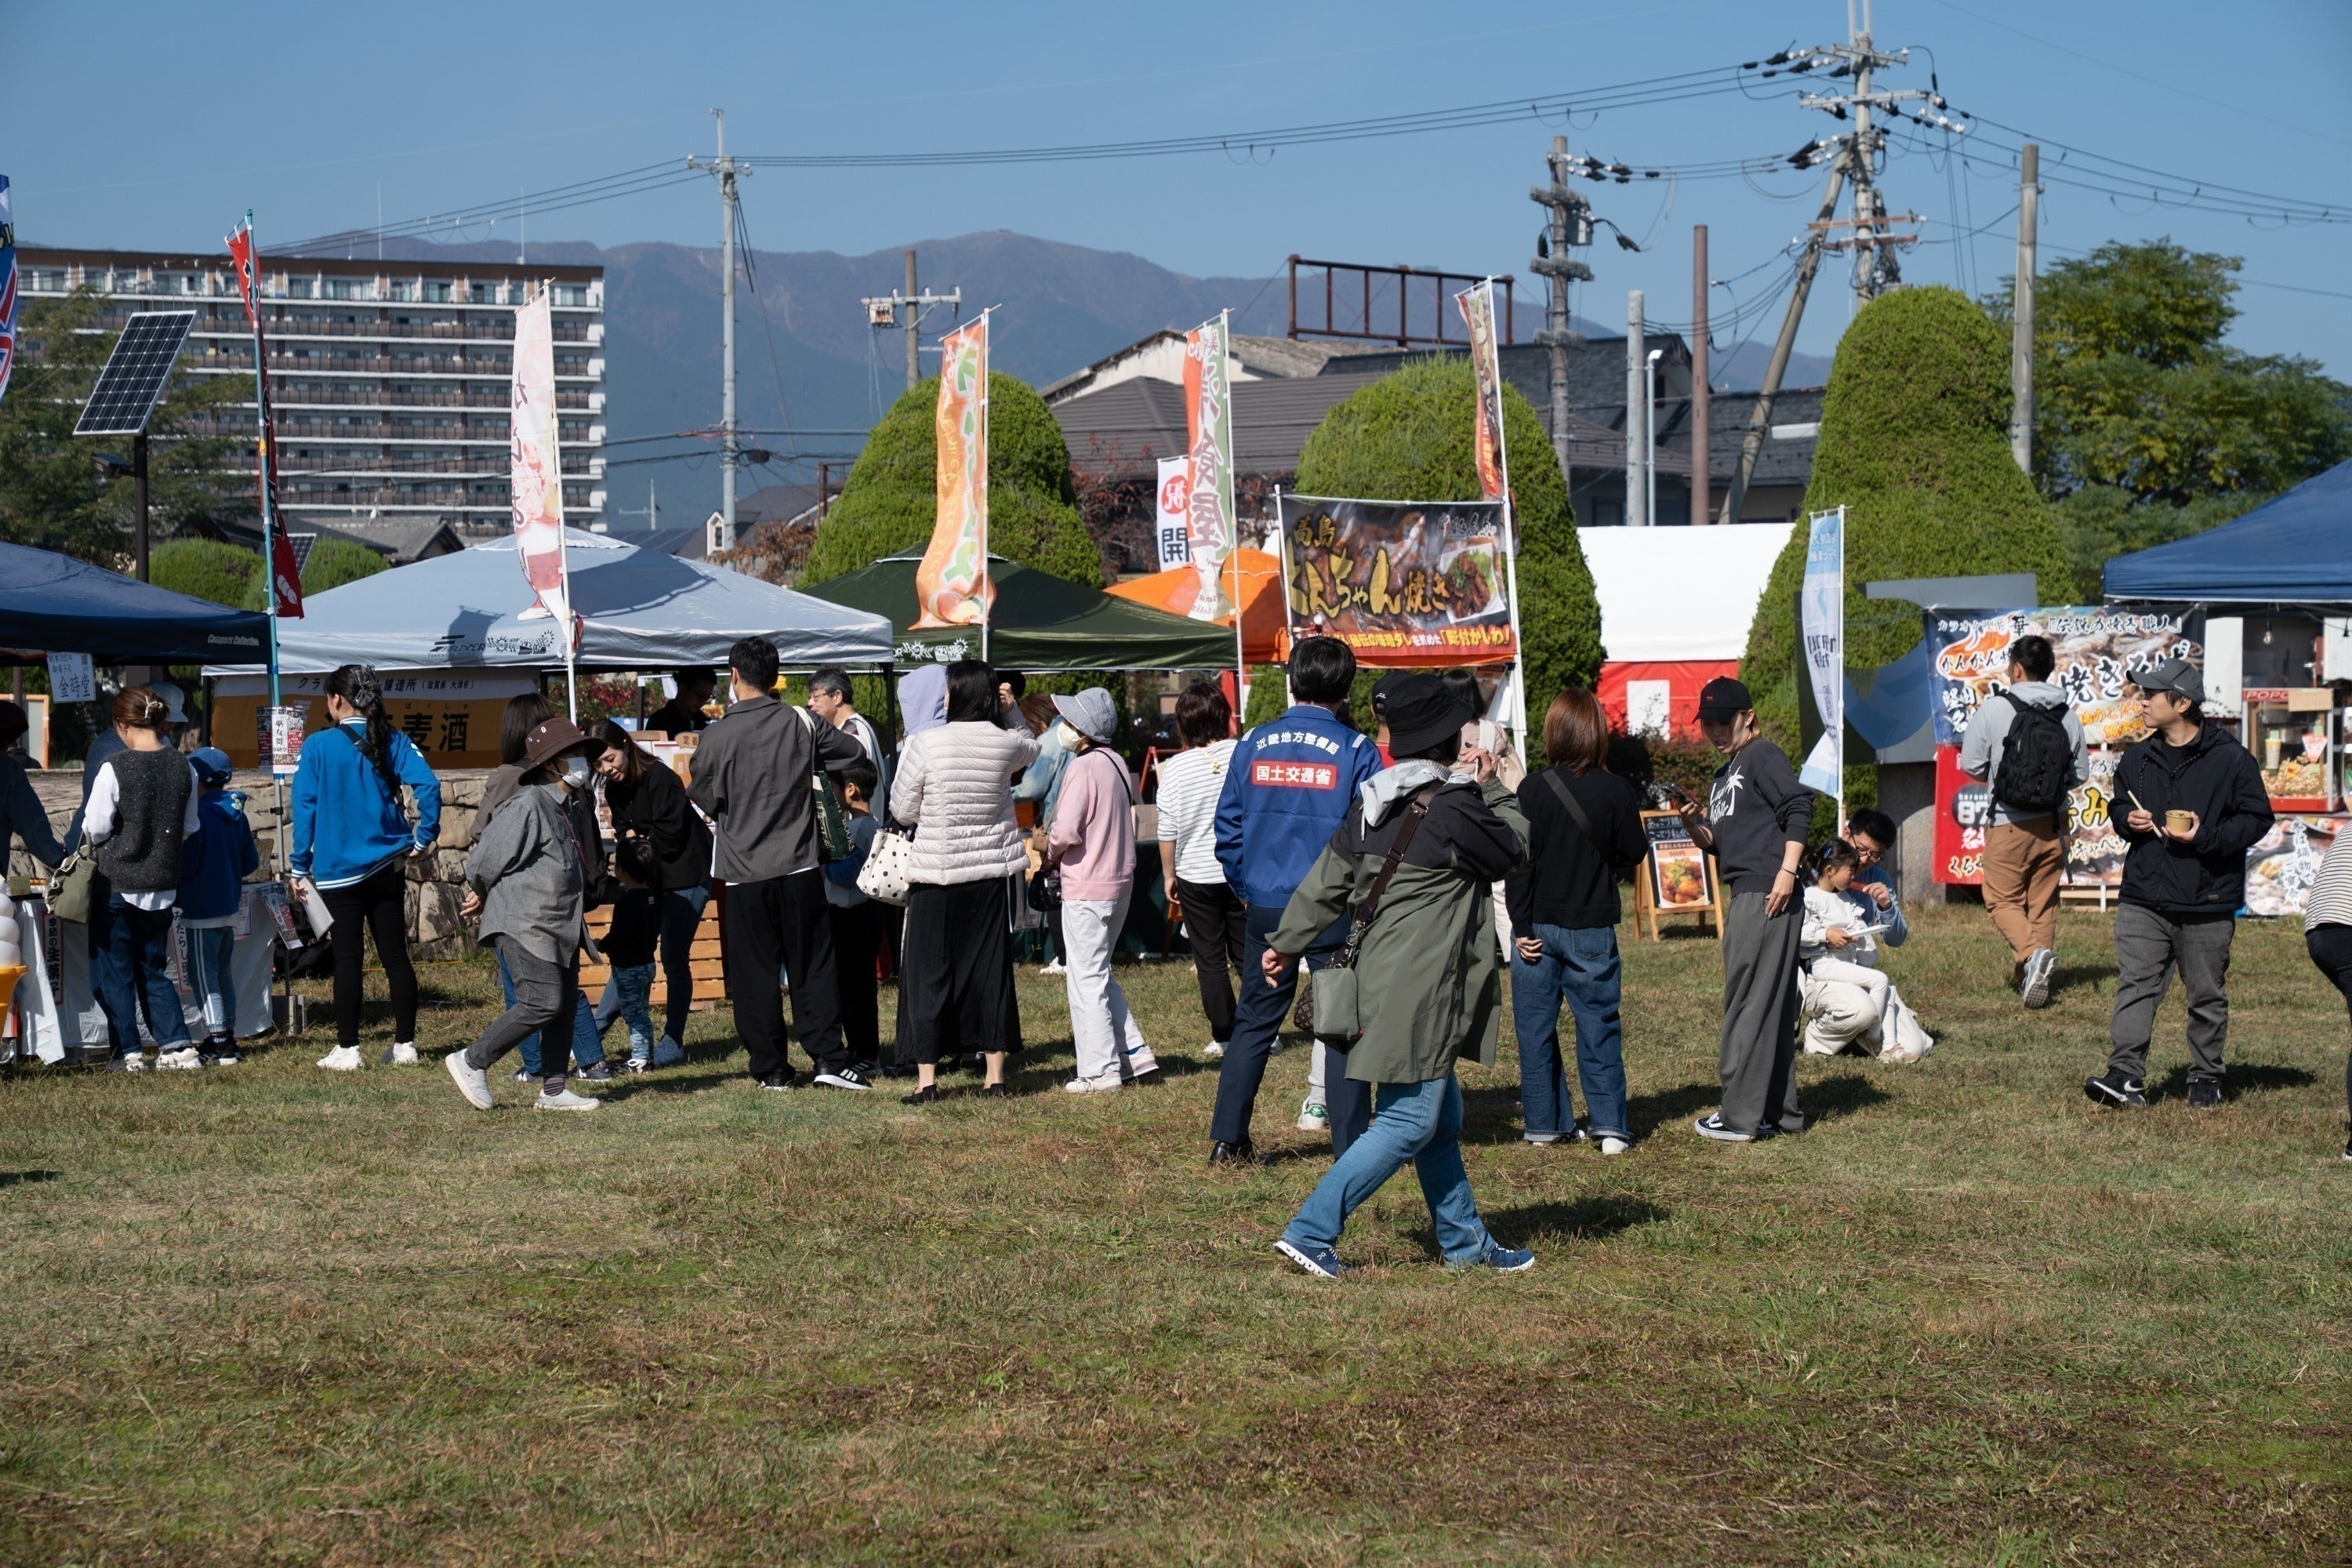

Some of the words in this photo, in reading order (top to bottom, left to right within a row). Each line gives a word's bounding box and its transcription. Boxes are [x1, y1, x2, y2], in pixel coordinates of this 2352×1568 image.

[1294, 514, 1337, 548] 高島
[58, 674, 90, 698] 金時堂
[1256, 731, 1340, 755] 近畿地方整備局
[1256, 764, 1332, 786] 国土交通省
